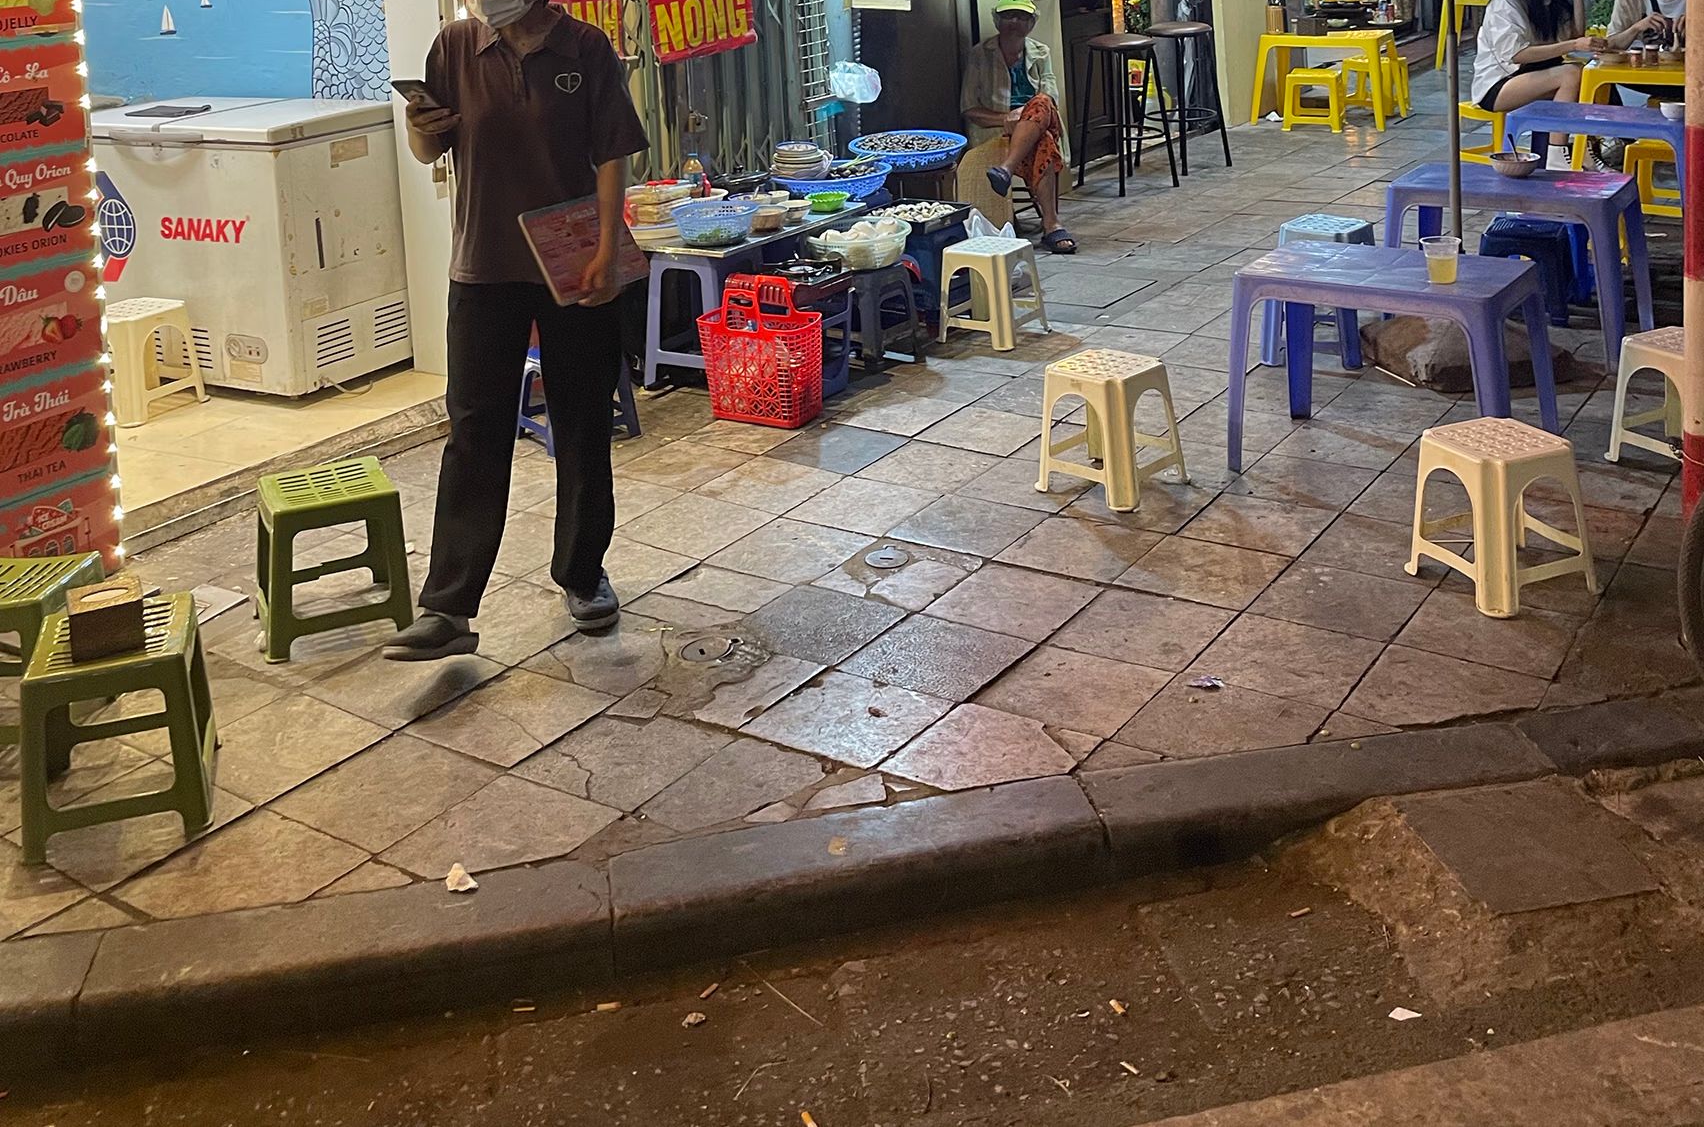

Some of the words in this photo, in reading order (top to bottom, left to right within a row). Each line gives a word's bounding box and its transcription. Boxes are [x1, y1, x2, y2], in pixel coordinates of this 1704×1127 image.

[35, 163, 71, 180] Orion
[32, 234, 67, 250] ORION
[160, 216, 246, 244] SANAKY
[1, 284, 39, 307] Dâu
[3, 400, 31, 423] Trà
[34, 389, 71, 413] Thái
[17, 467, 46, 485] THAI
[47, 459, 67, 476] TEA
